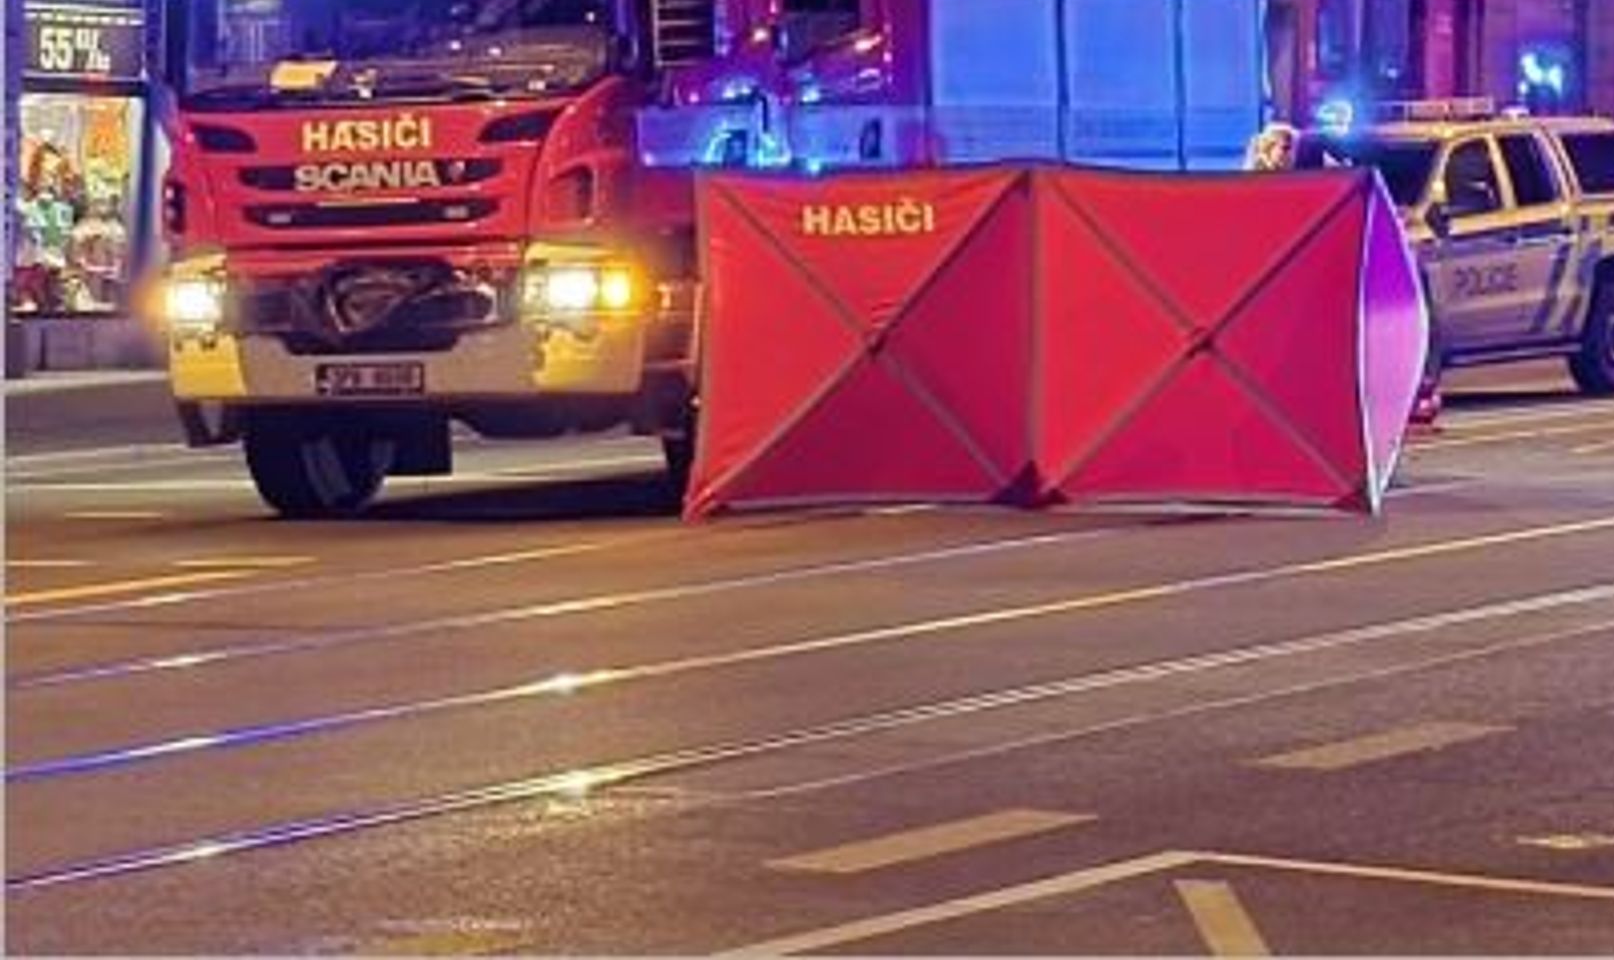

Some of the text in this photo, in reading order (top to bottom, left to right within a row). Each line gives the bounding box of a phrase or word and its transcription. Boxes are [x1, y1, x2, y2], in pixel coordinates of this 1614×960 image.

[301, 113, 432, 152] HASIČI
[294, 160, 440, 190] SCANIA
[802, 197, 934, 235] HASIČI
